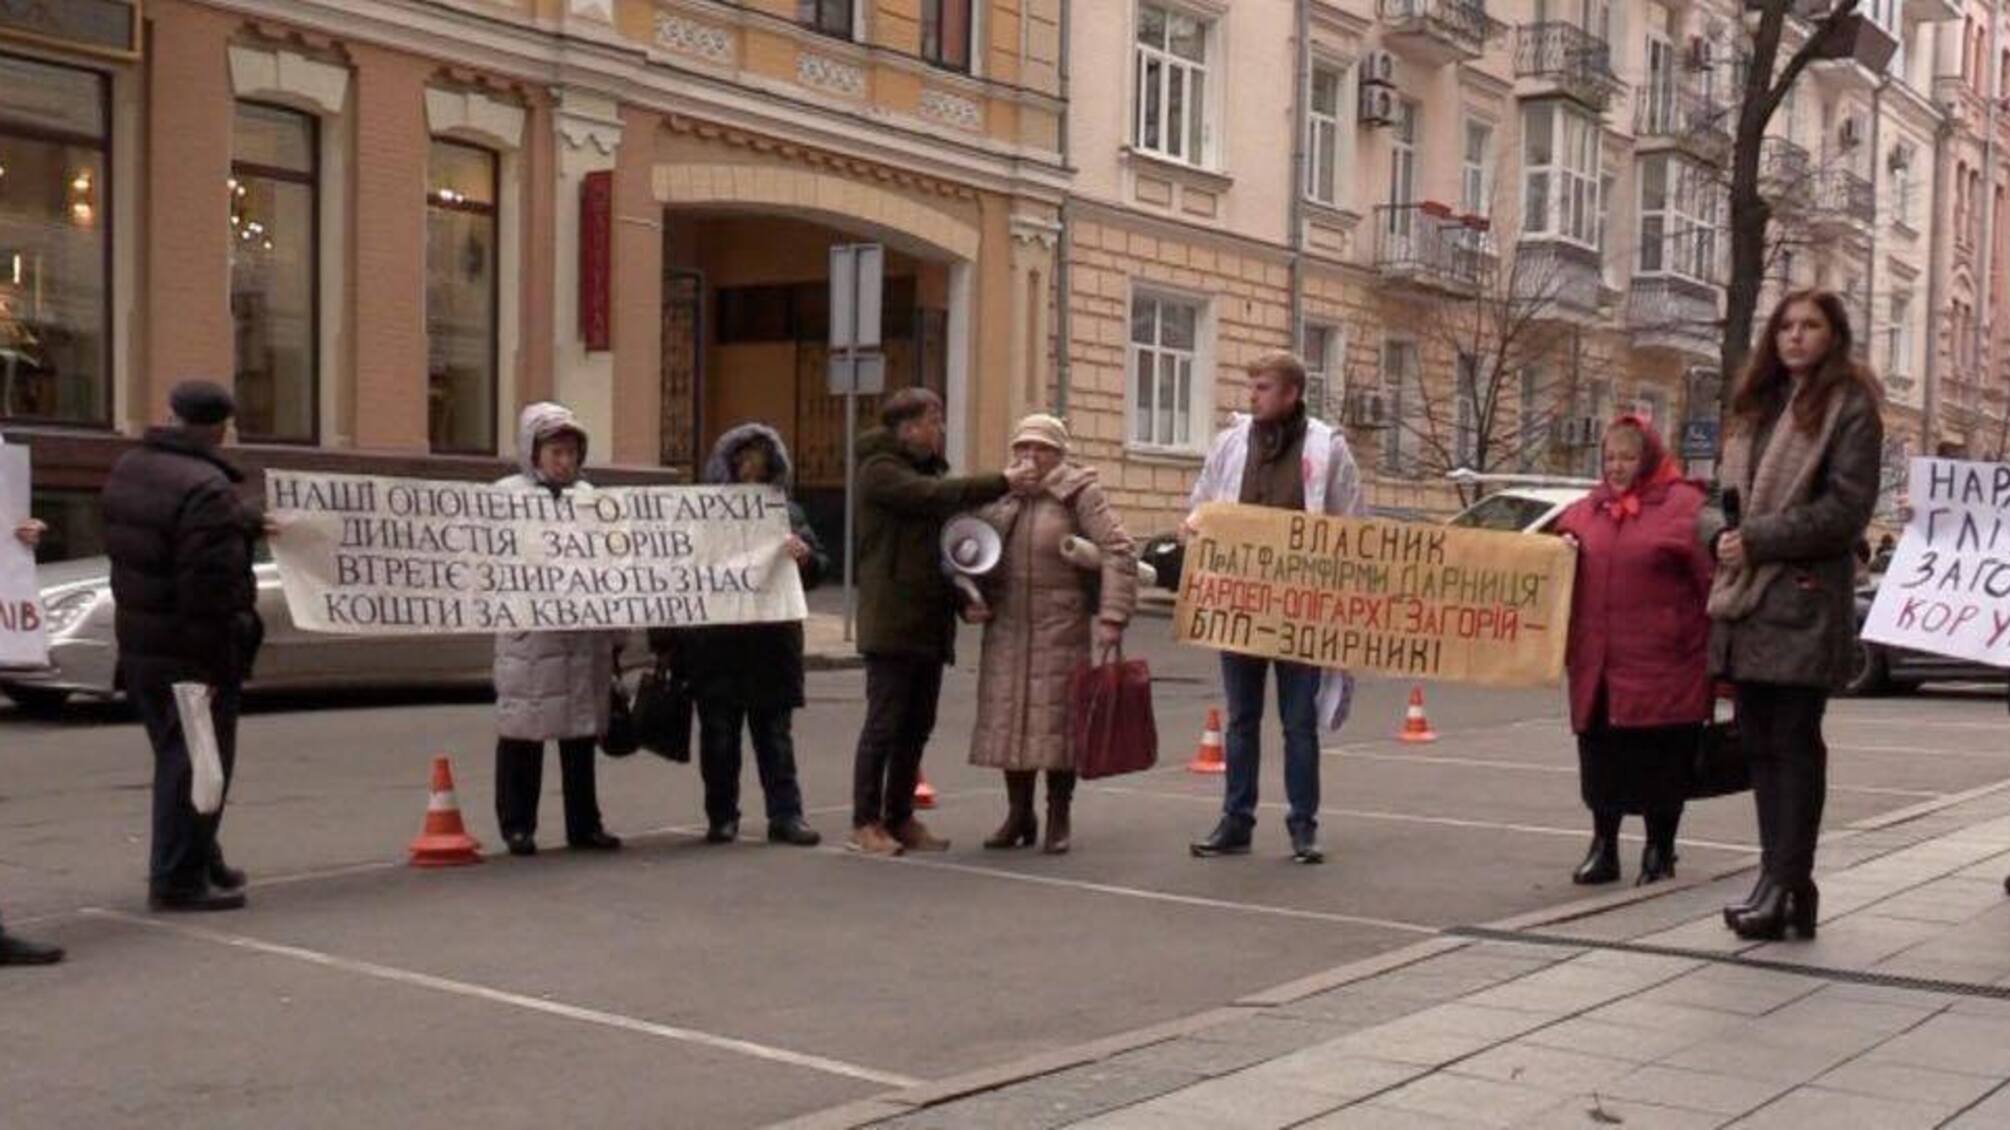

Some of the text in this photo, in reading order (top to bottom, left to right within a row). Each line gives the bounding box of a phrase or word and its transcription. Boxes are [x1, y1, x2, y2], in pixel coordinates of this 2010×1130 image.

[274, 479, 376, 513] НАШІ
[1928, 462, 2010, 508] НАР
[339, 515, 694, 559] ДИНАСТІЯ ЗАГОРІЇВ
[1288, 516, 1446, 565] ВЛАСНИК
[336, 553, 469, 589] ВТРЕТЄ
[477, 561, 669, 594] ЗДИРАЮТЬ
[1257, 546, 1390, 595] ФАРМФІРМИ
[325, 594, 708, 628] КОШТИ ЗА КВАРТИРИ
[1896, 597, 2010, 648] КОРУ
